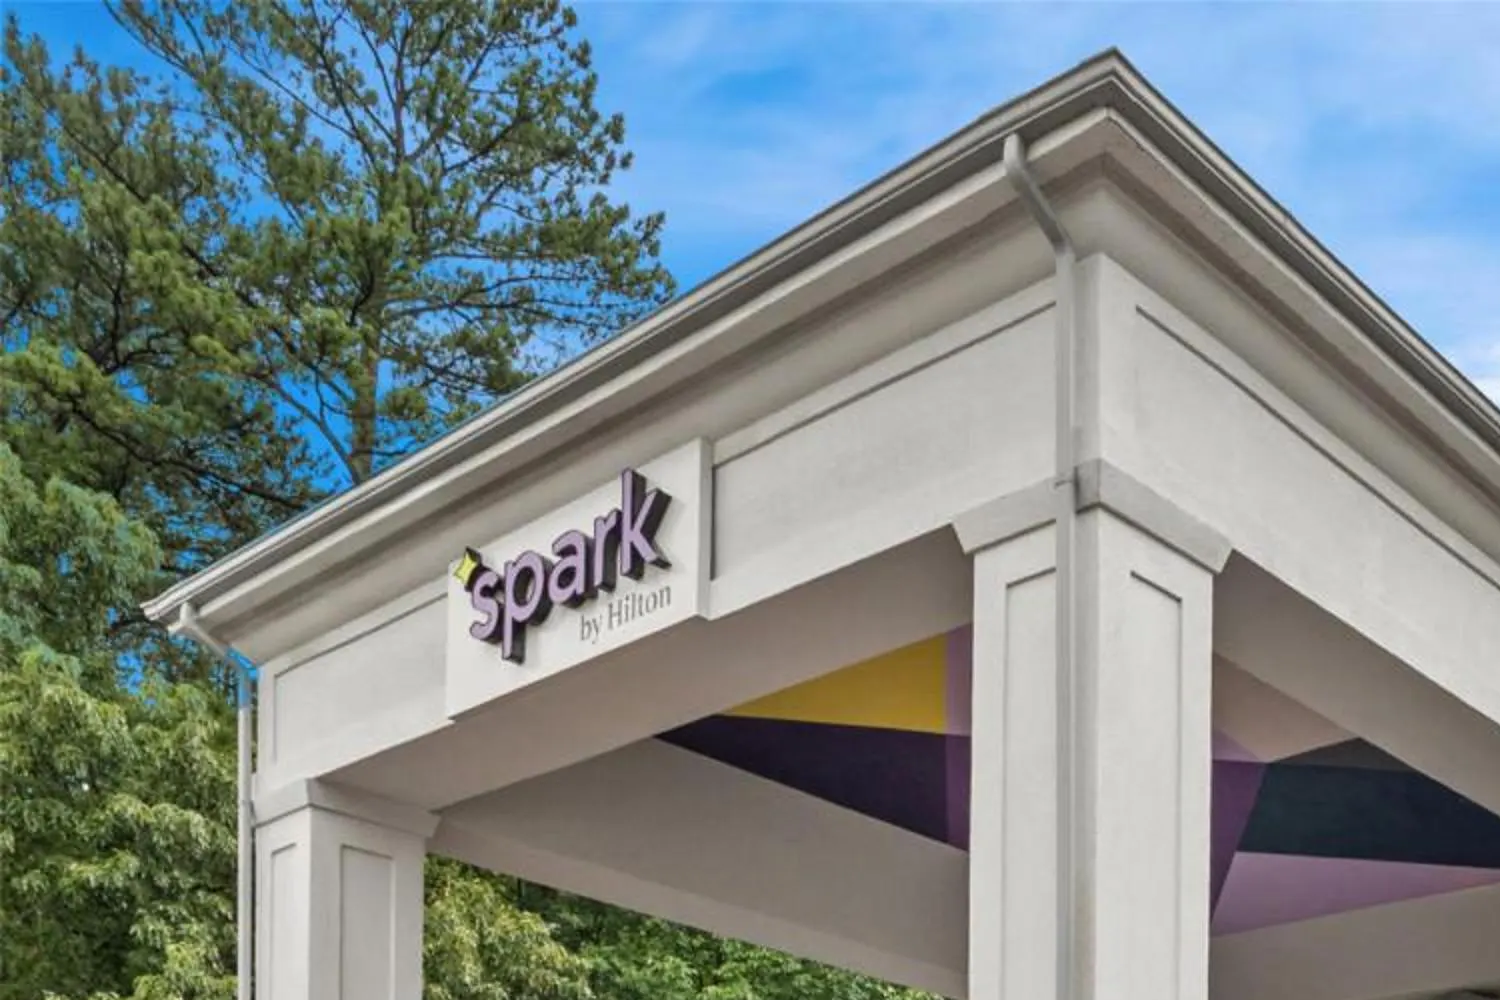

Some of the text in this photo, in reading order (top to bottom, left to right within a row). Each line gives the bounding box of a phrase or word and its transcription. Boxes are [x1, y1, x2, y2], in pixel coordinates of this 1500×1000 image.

[469, 467, 672, 665] spark
[579, 585, 672, 644] by Hilton
